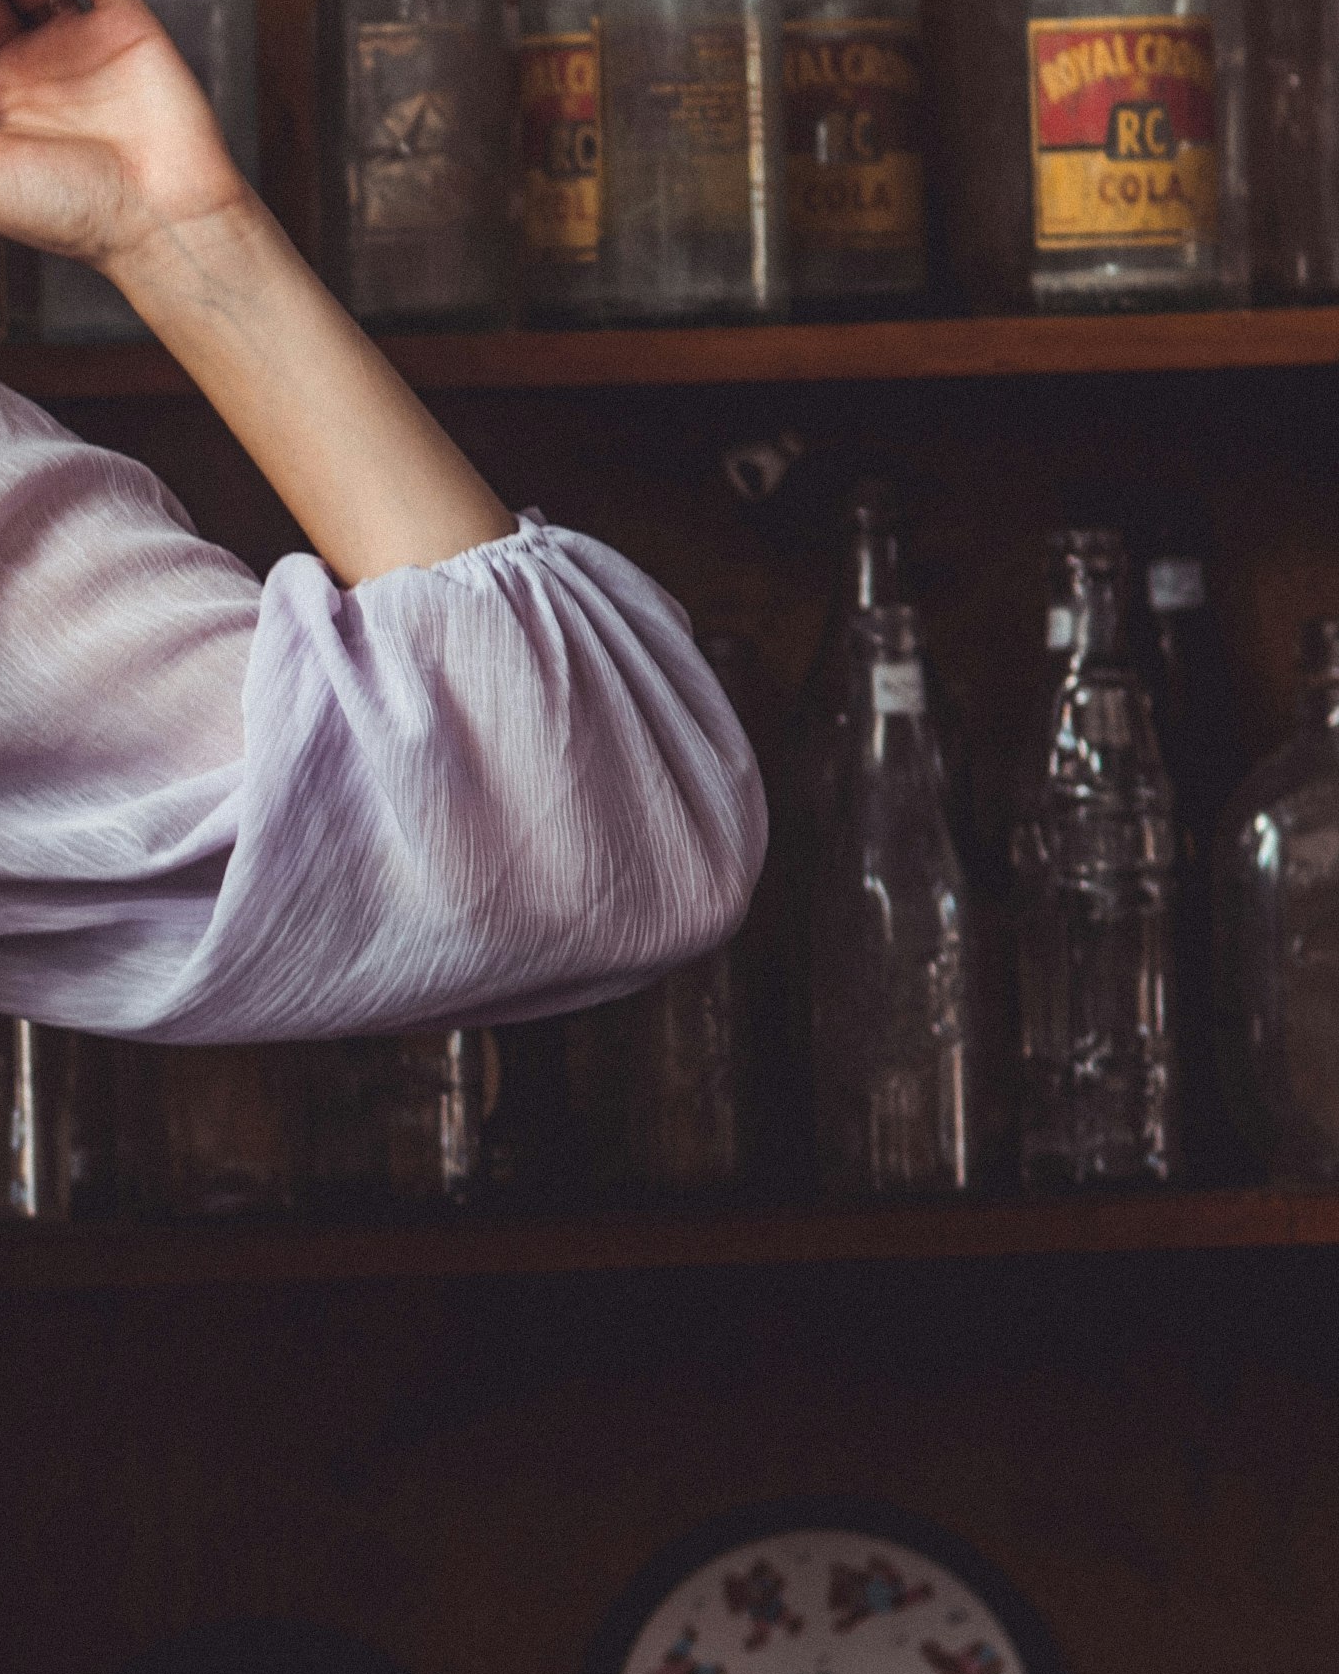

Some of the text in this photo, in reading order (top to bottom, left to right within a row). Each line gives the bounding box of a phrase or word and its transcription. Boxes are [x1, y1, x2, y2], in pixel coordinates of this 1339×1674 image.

[1040, 33, 1133, 105] ROYAL
[1116, 108, 1168, 157] RC
[1099, 173, 1187, 205] COLA
